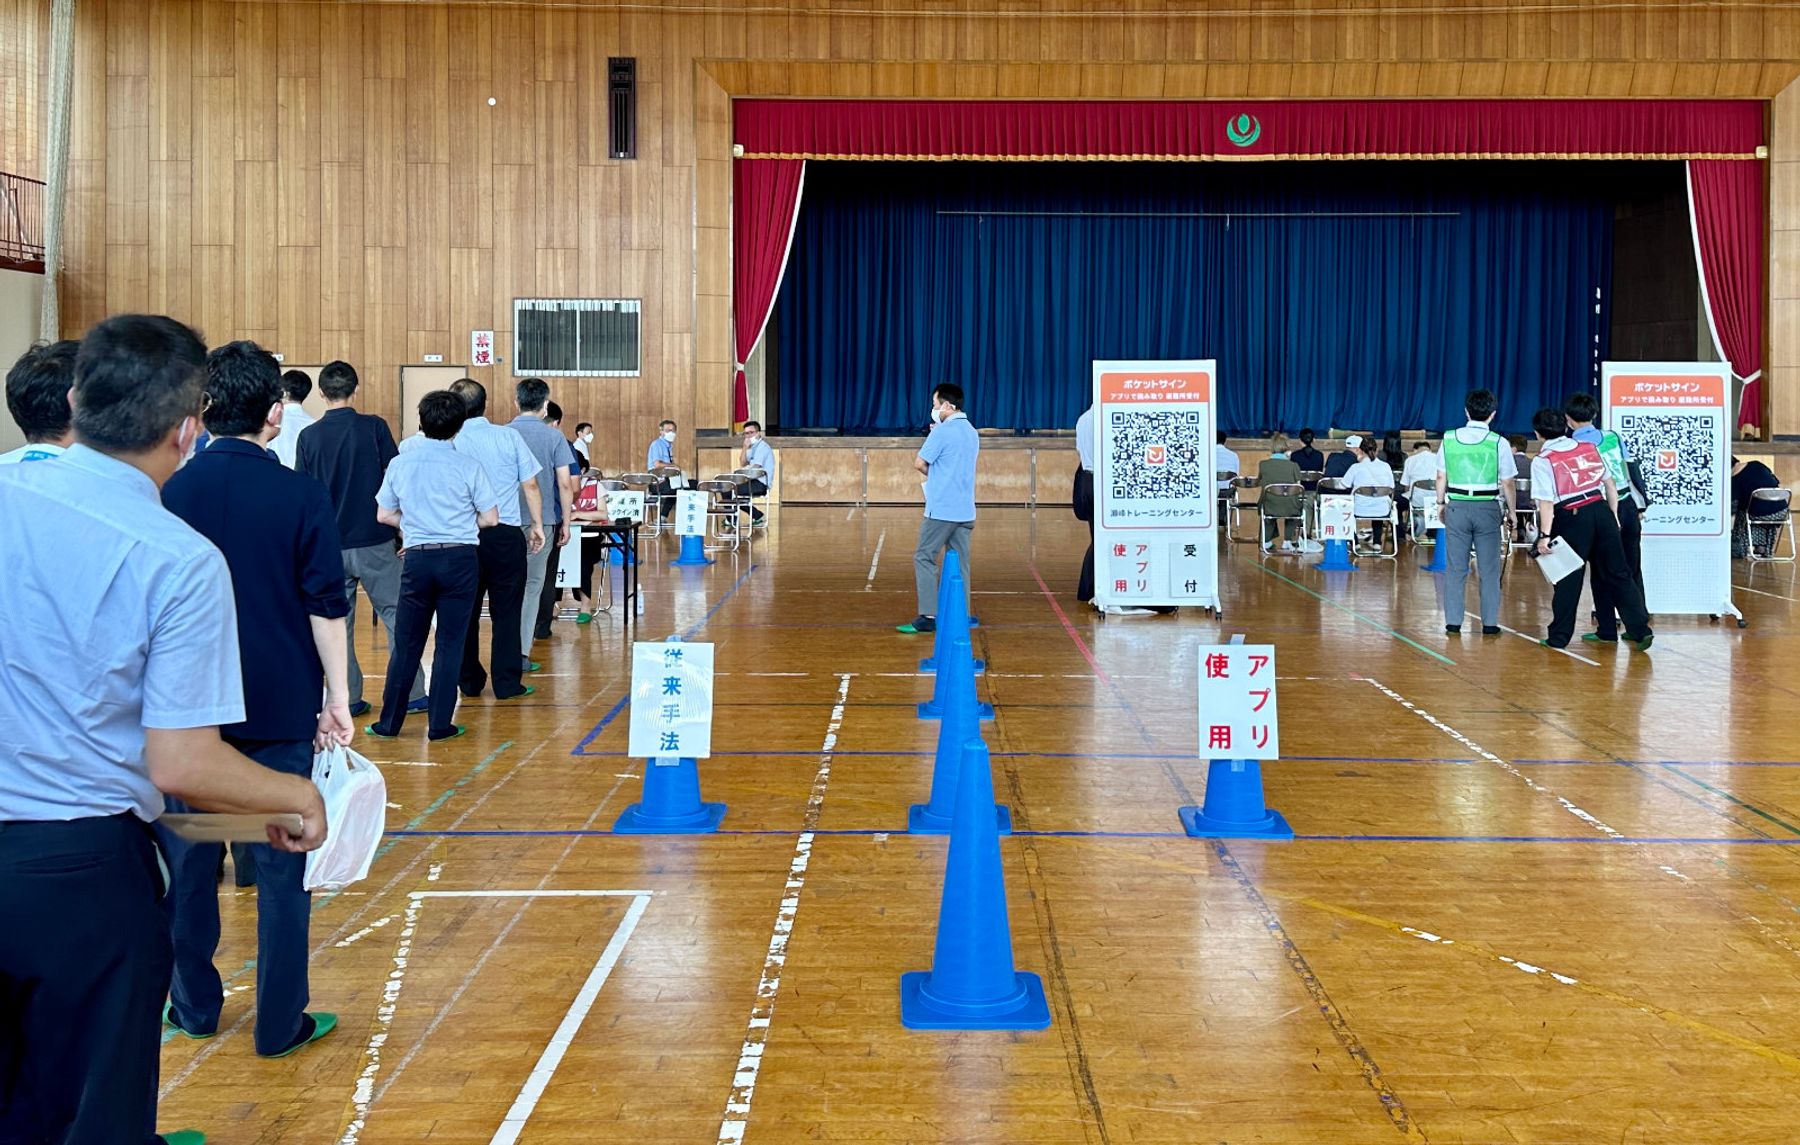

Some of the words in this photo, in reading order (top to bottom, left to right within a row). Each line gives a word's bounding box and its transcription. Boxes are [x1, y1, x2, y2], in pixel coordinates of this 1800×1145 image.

[476, 333, 490, 364] 禁煙
[1123, 379, 1188, 390] ポケットサイン
[1633, 382, 1700, 393] ポケットサイン
[1113, 543, 1128, 592] 使用
[1136, 544, 1148, 592] アプリ
[1183, 543, 1198, 593] 受付
[660, 648, 683, 751] 従来手法
[1205, 653, 1231, 749] 使用
[1248, 654, 1271, 749] アプリ
